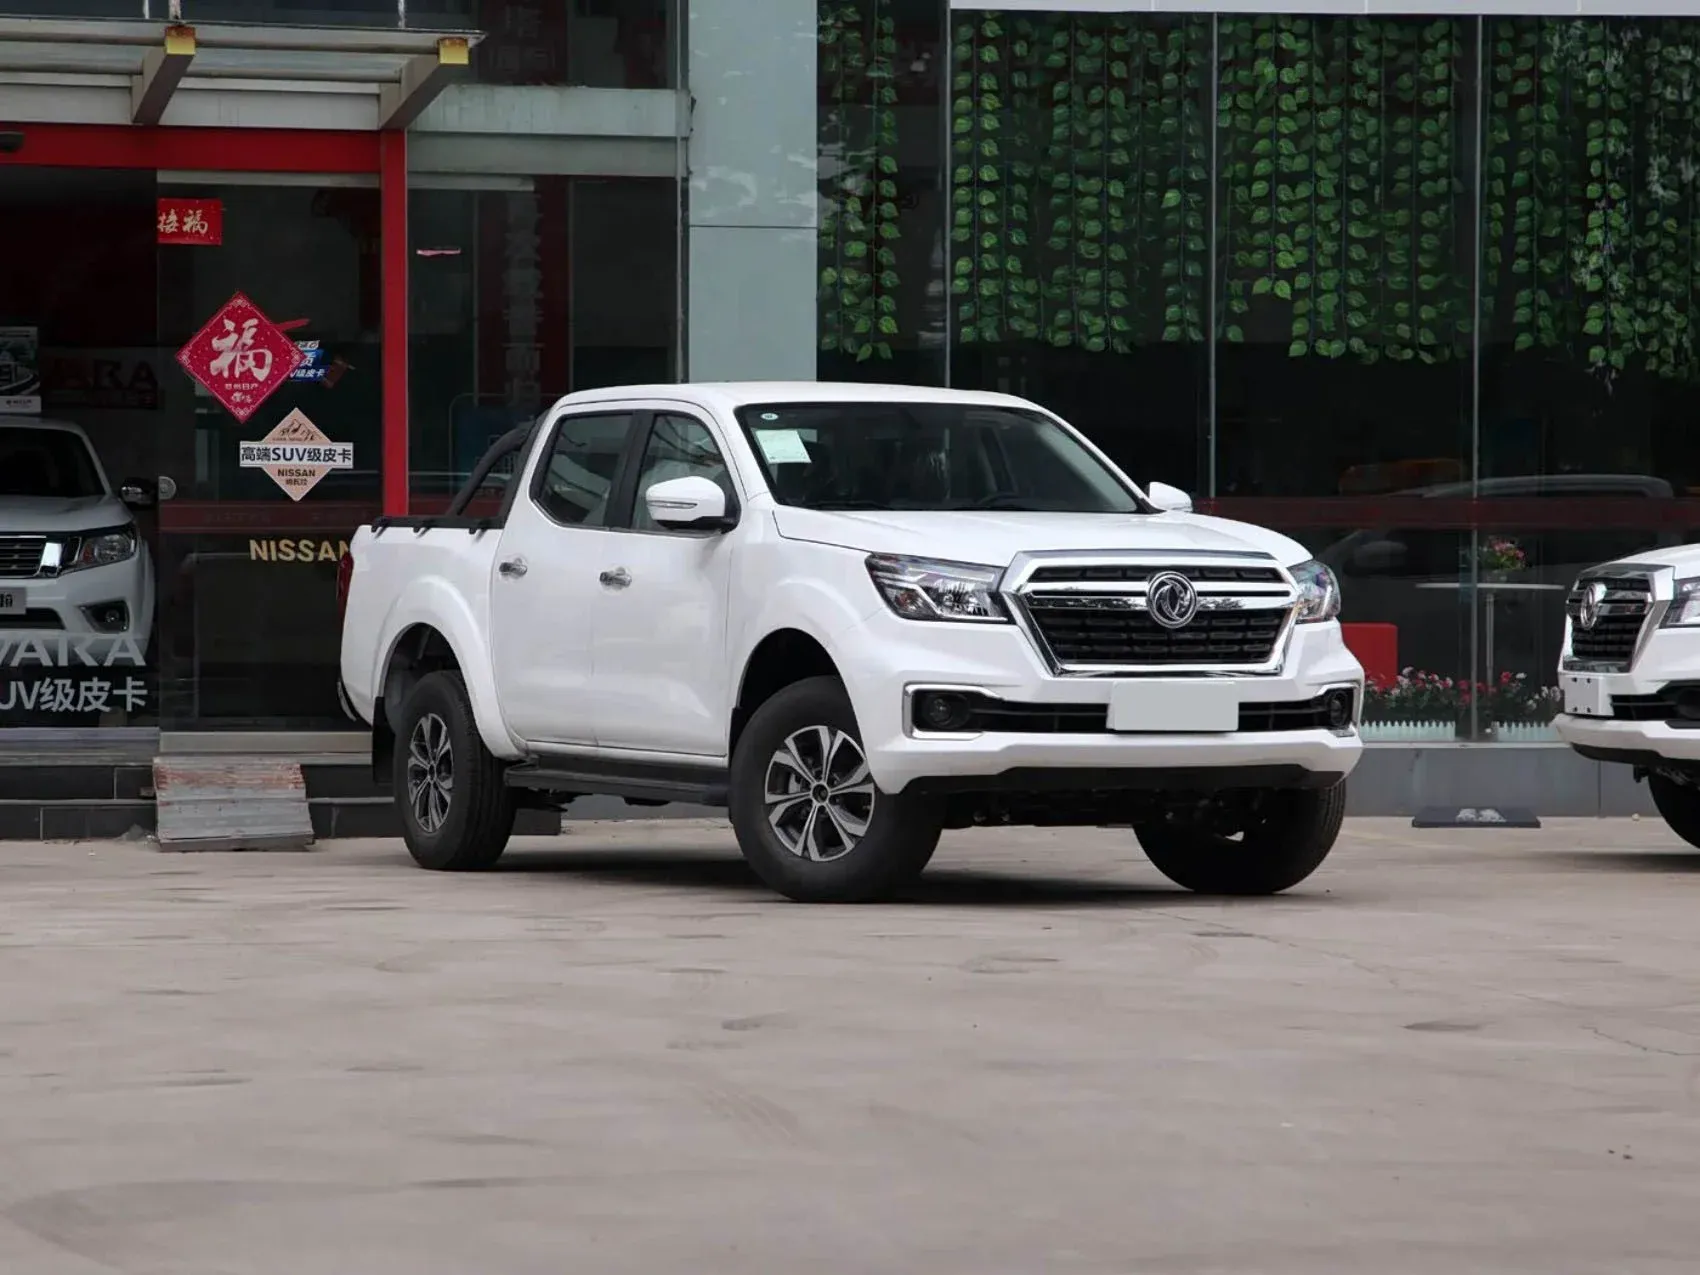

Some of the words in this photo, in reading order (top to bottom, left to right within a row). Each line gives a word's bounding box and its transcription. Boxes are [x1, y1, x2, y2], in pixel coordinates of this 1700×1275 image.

[209, 317, 273, 382] 福
[241, 446, 352, 463] 高端SUV级皮卡
[277, 468, 316, 478] NISSAN
